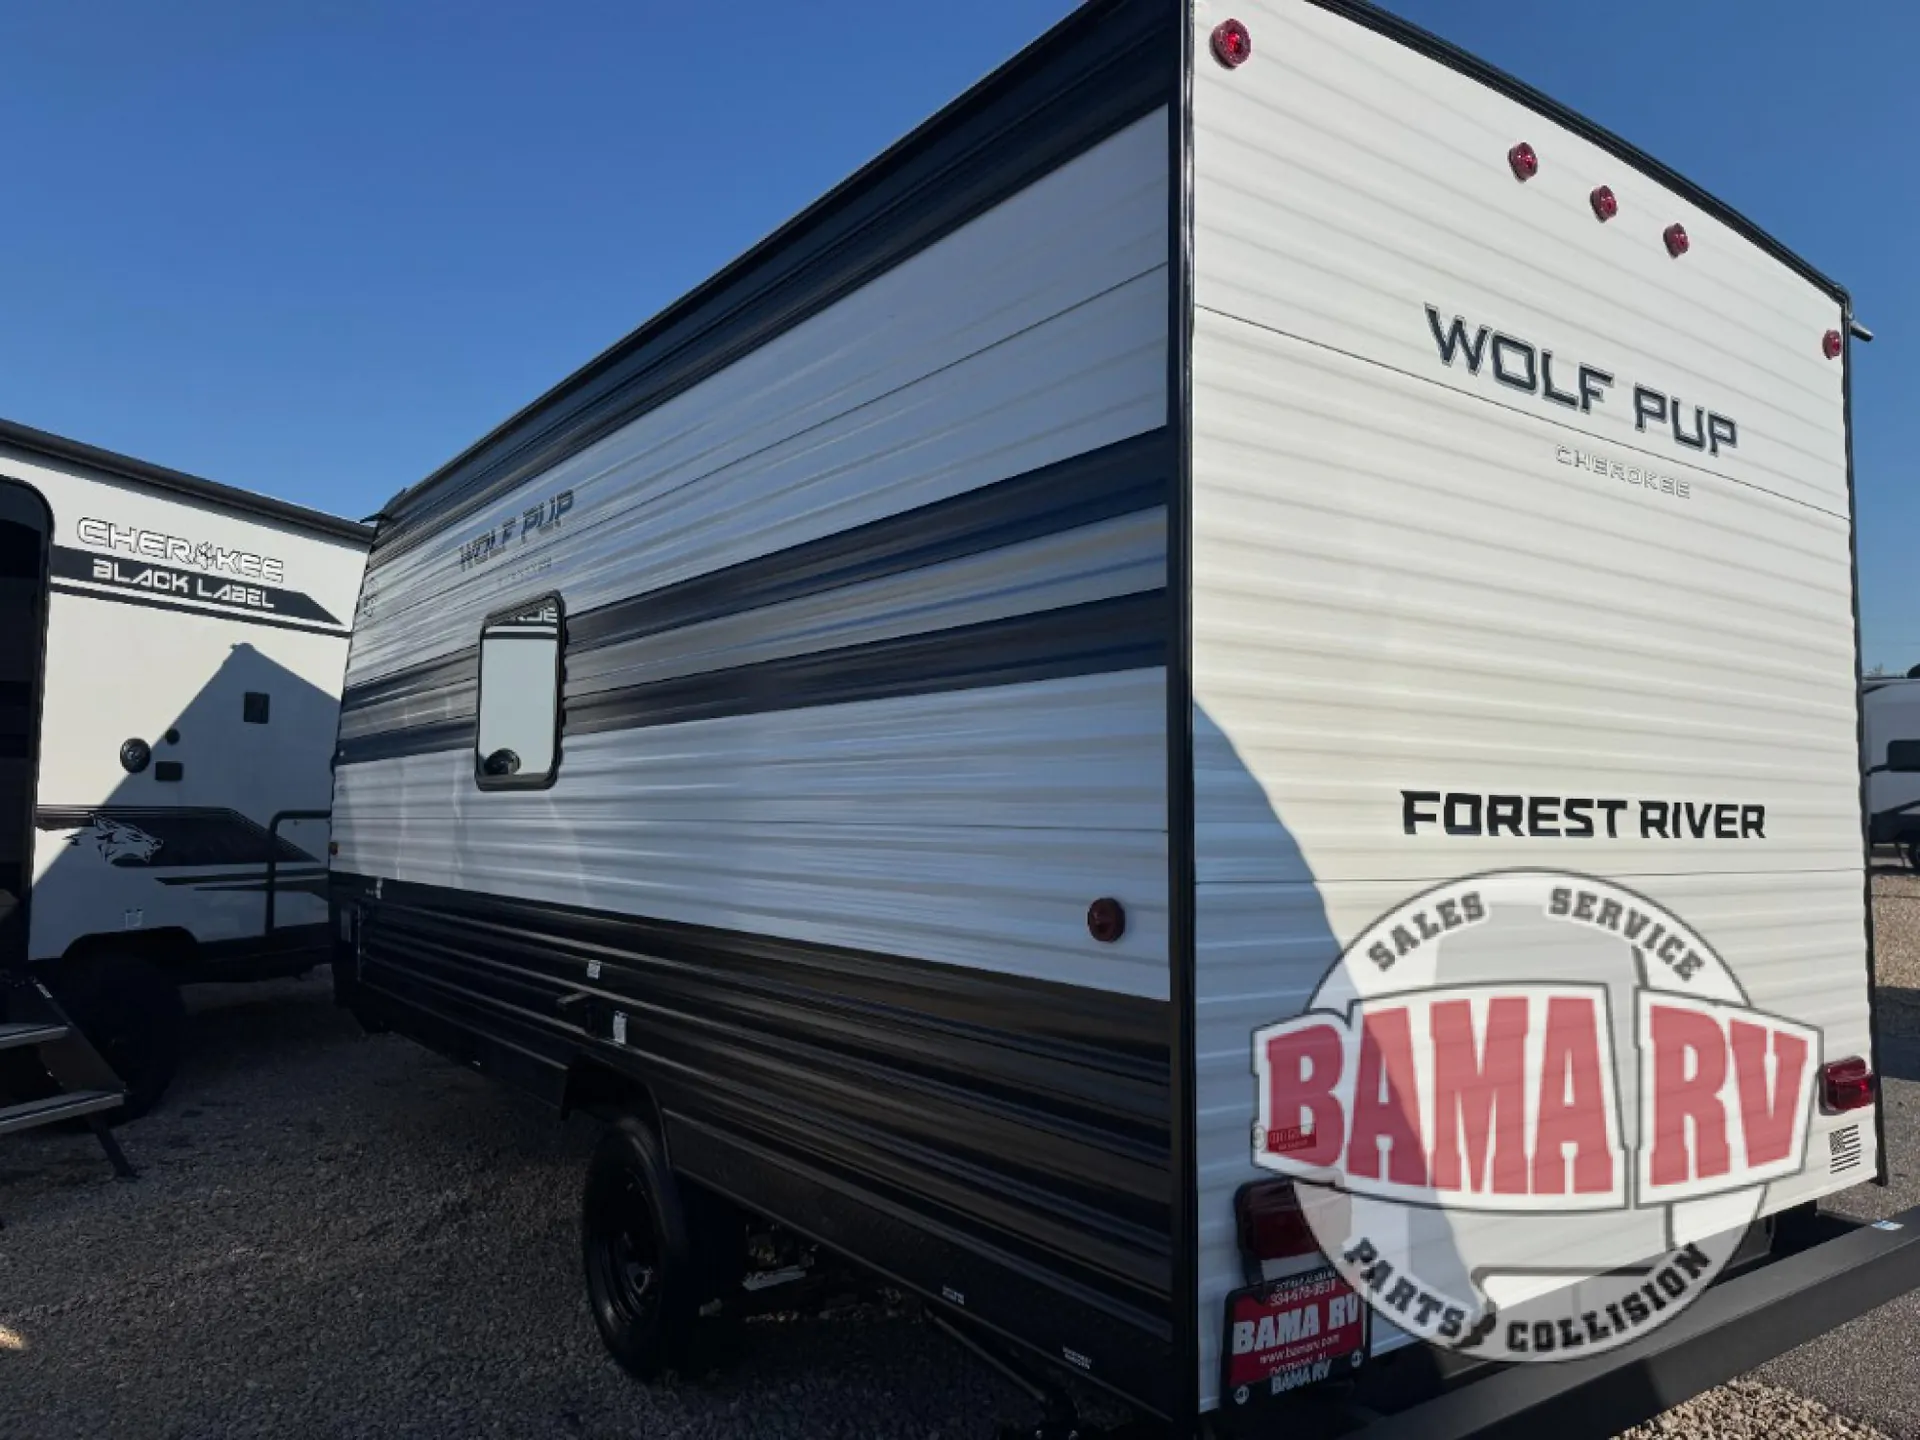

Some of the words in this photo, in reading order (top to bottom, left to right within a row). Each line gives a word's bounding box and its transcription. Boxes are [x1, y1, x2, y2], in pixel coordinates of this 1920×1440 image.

[1424, 302, 1614, 415] WOLF
[1634, 382, 1737, 457] PUP
[1555, 445, 1690, 498] CHEROKEE
[93, 558, 190, 594] BLACK
[197, 578, 275, 609] LABEL
[1400, 790, 1628, 837] FOREST
[1638, 799, 1767, 839] RIVER
[1232, 1303, 1320, 1355] BAMA
[1327, 1292, 1359, 1330] RV
